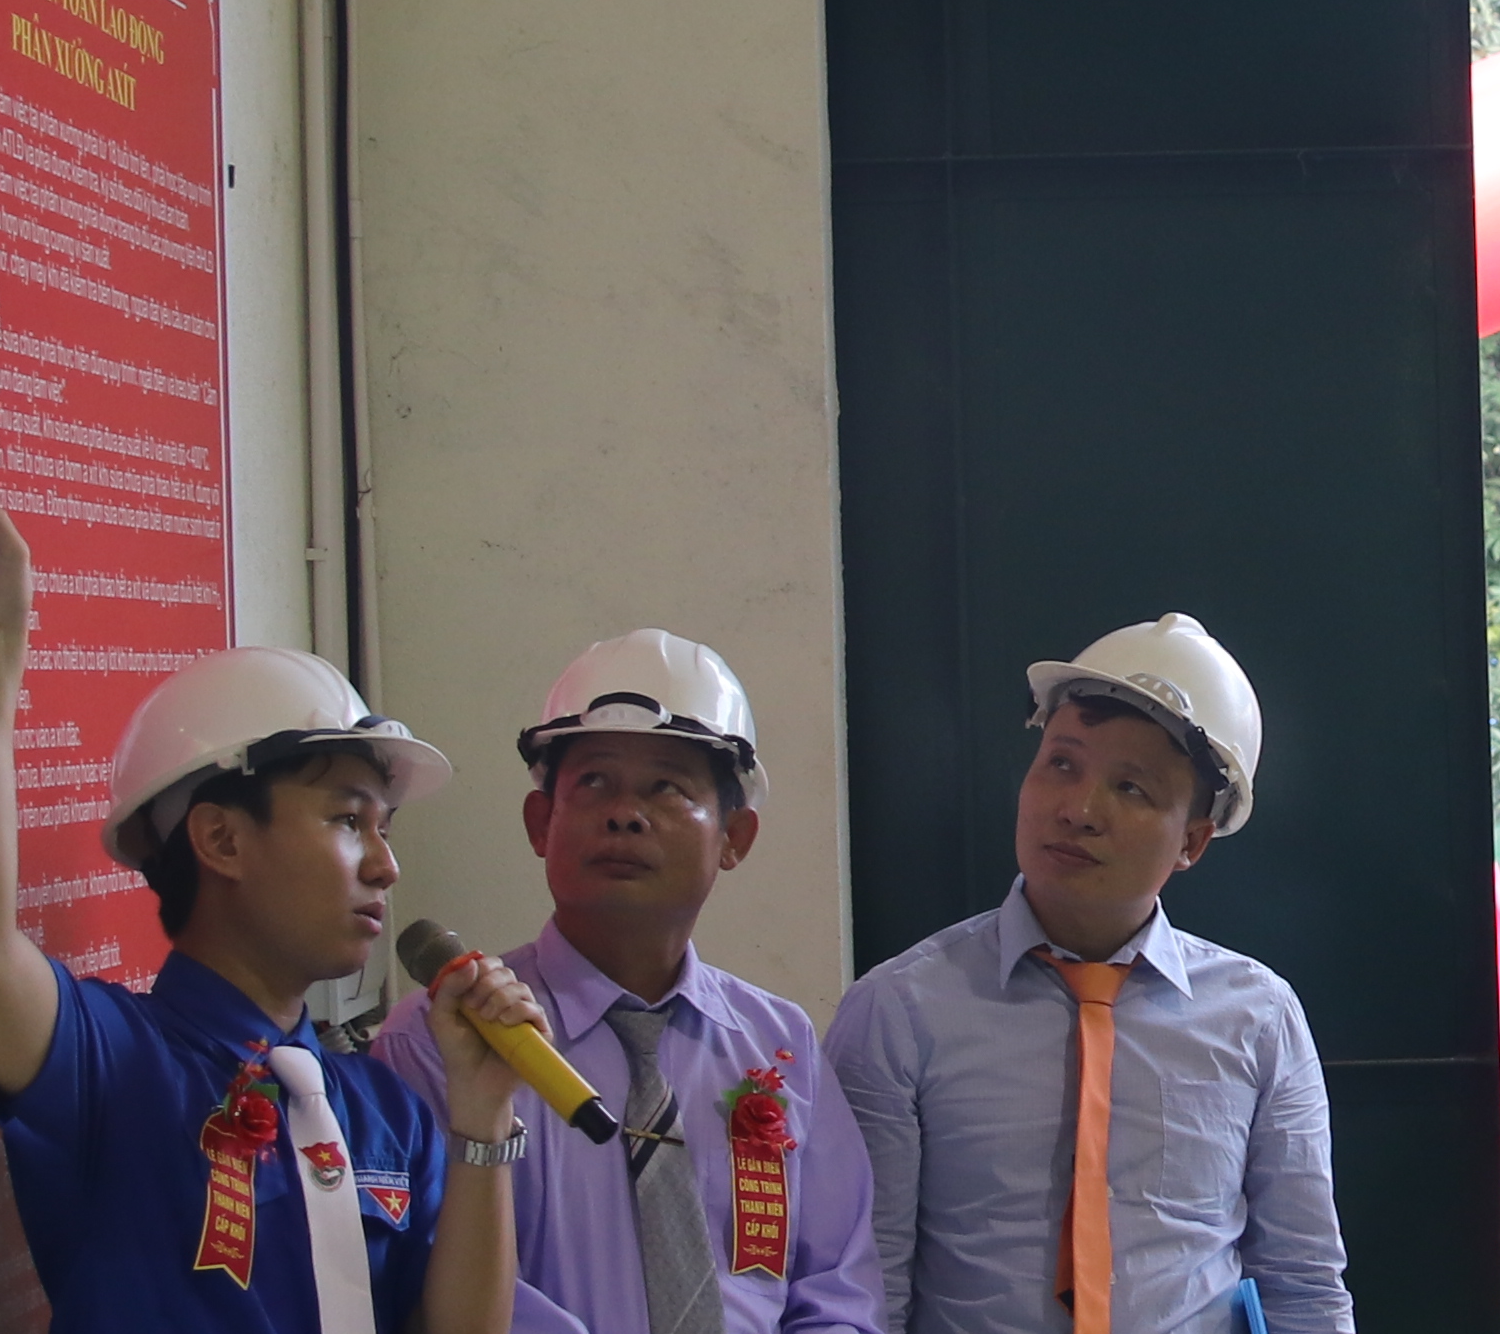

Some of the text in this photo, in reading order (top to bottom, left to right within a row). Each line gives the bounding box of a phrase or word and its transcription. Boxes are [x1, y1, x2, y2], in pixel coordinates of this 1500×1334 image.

[128, 15, 164, 64] ĐỘNG
[12, 13, 136, 110] PHÂN XƯỞNG AXÍT
[739, 1175, 759, 1193] CÔNG
[740, 1199, 765, 1215] THANH
